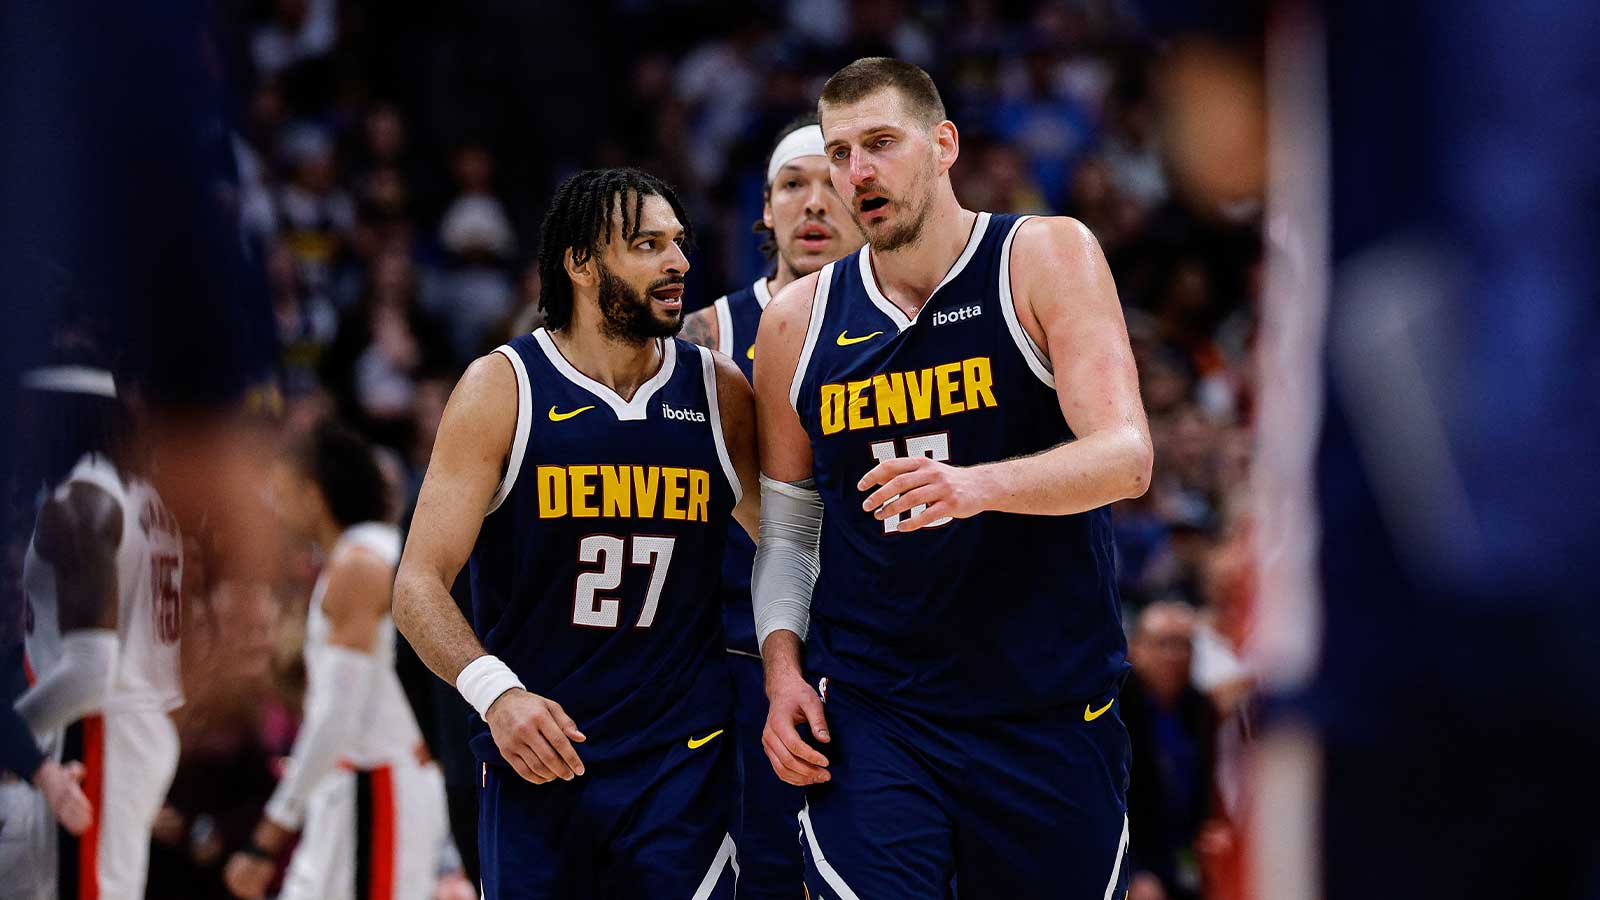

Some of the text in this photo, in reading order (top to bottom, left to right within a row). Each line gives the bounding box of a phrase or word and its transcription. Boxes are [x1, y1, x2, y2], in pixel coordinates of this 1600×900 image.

[932, 304, 982, 327] ibotta
[662, 404, 706, 422] ibotta
[820, 357, 997, 435] DENVER
[536, 465, 710, 522] DENVER
[573, 533, 676, 628] 27
